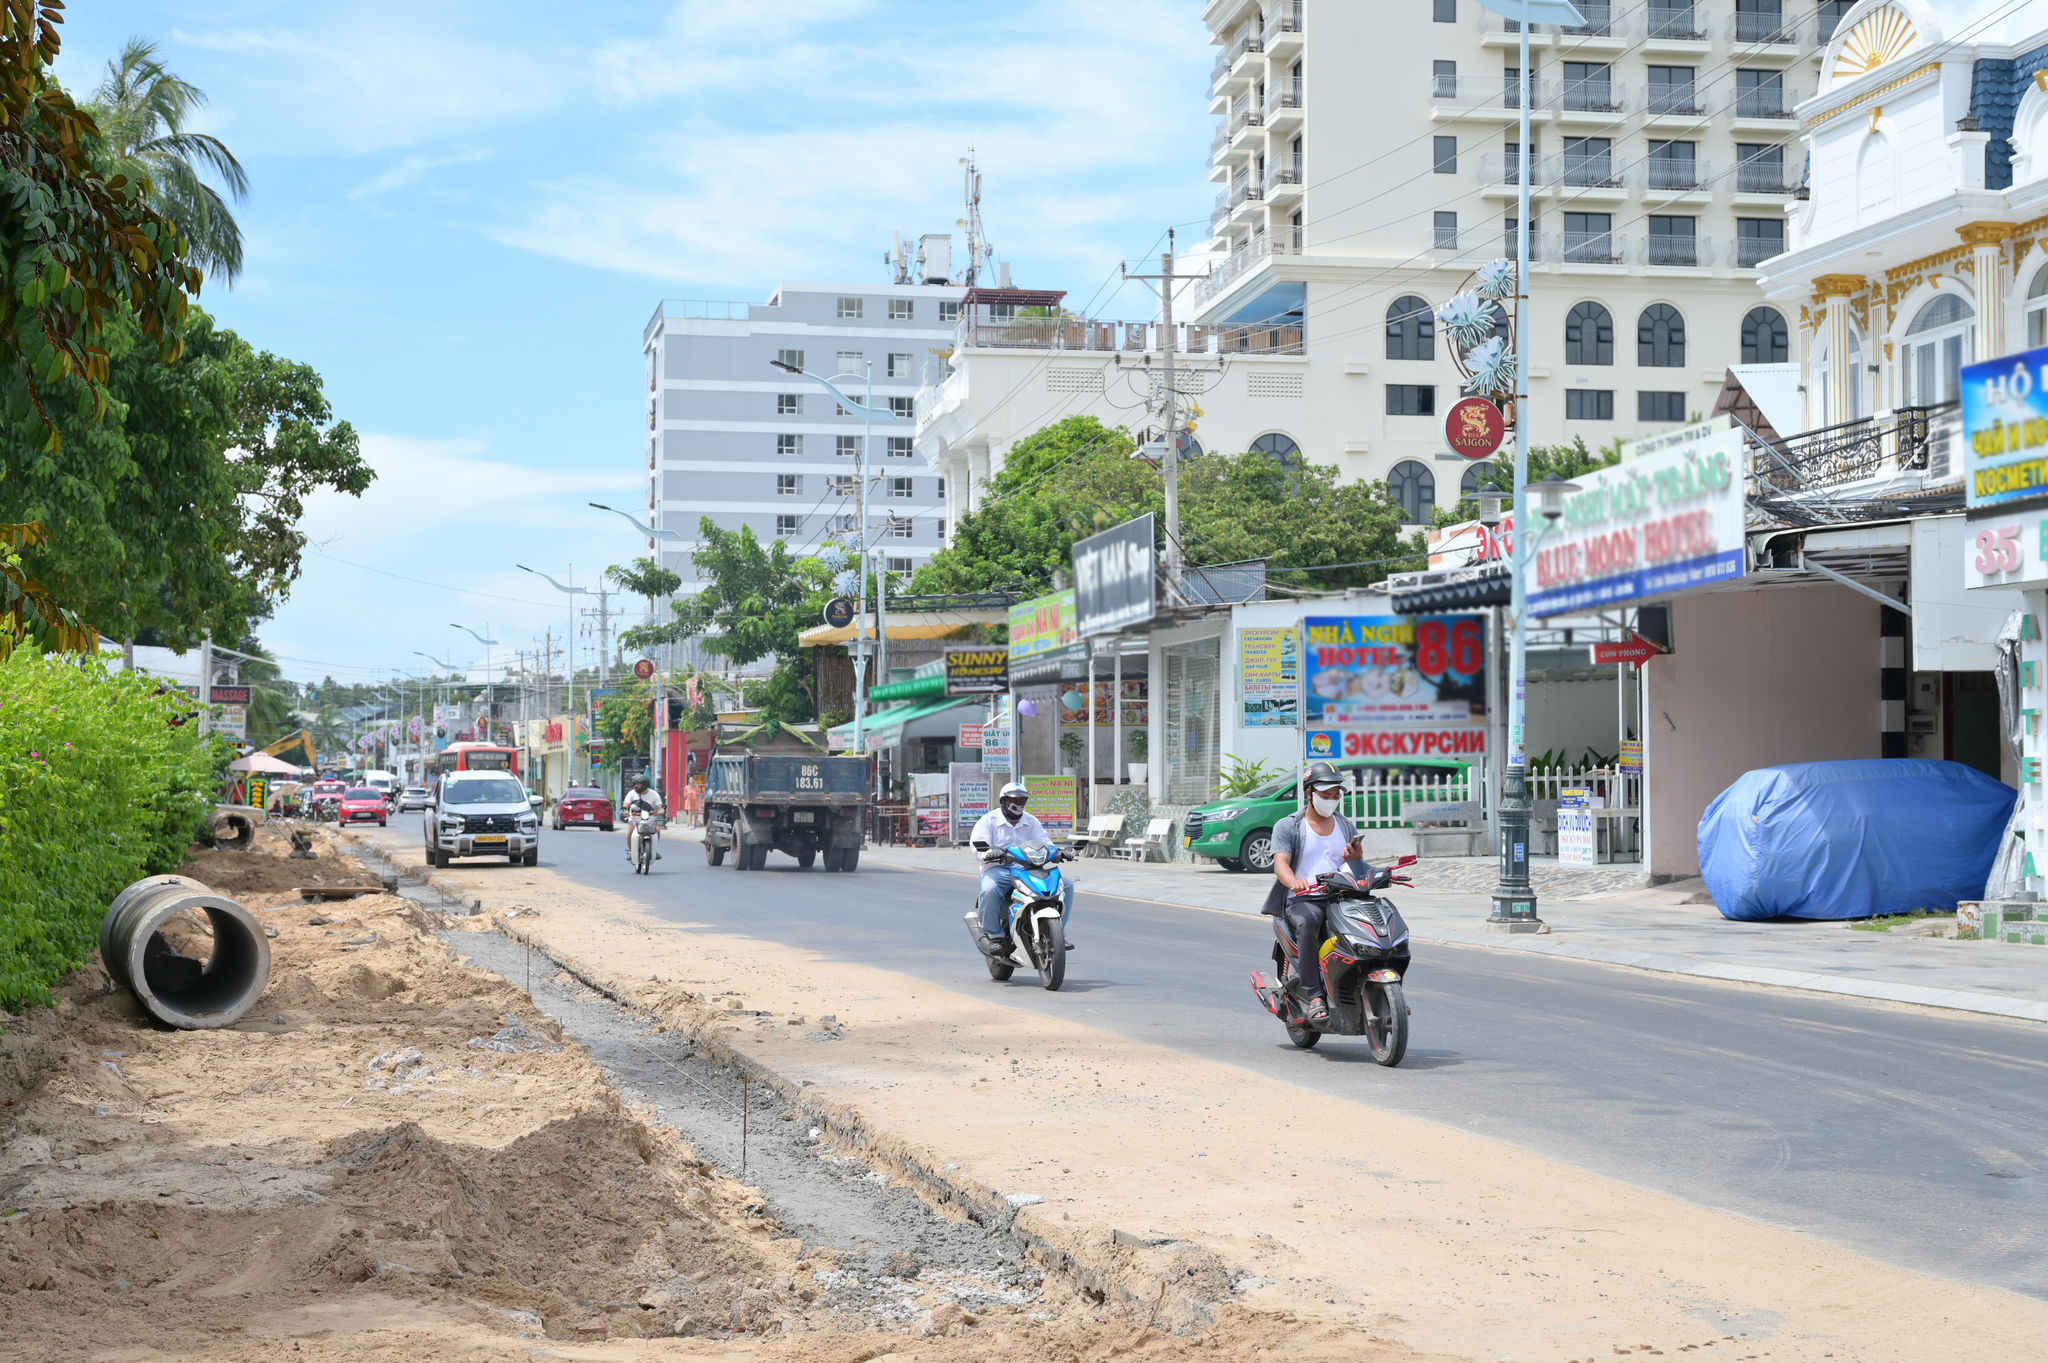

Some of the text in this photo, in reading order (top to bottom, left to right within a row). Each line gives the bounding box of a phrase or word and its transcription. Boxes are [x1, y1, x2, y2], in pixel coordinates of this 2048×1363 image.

[1455, 437, 1493, 447] SAIGON
[1971, 419, 2005, 458] ЧАЙ
[2007, 423, 2020, 452] И
[1536, 509, 1712, 587] BLUE MOON HOTEL
[1975, 524, 2021, 575] 35
[1309, 621, 1354, 644] NHÀ
[1416, 620, 1483, 675] 86
[1619, 647, 1647, 657] PHÒNG
[948, 651, 1008, 667] SUNNY
[1317, 647, 1403, 667] HOTEL
[950, 666, 1006, 677] HOMESTAY
[985, 738, 999, 747] 86
[1345, 731, 1485, 755] ЭКСКУРСИИ
[983, 747, 1010, 755] LAUNDRY
[801, 765, 819, 776] 86C
[795, 777, 824, 789] 183.61
